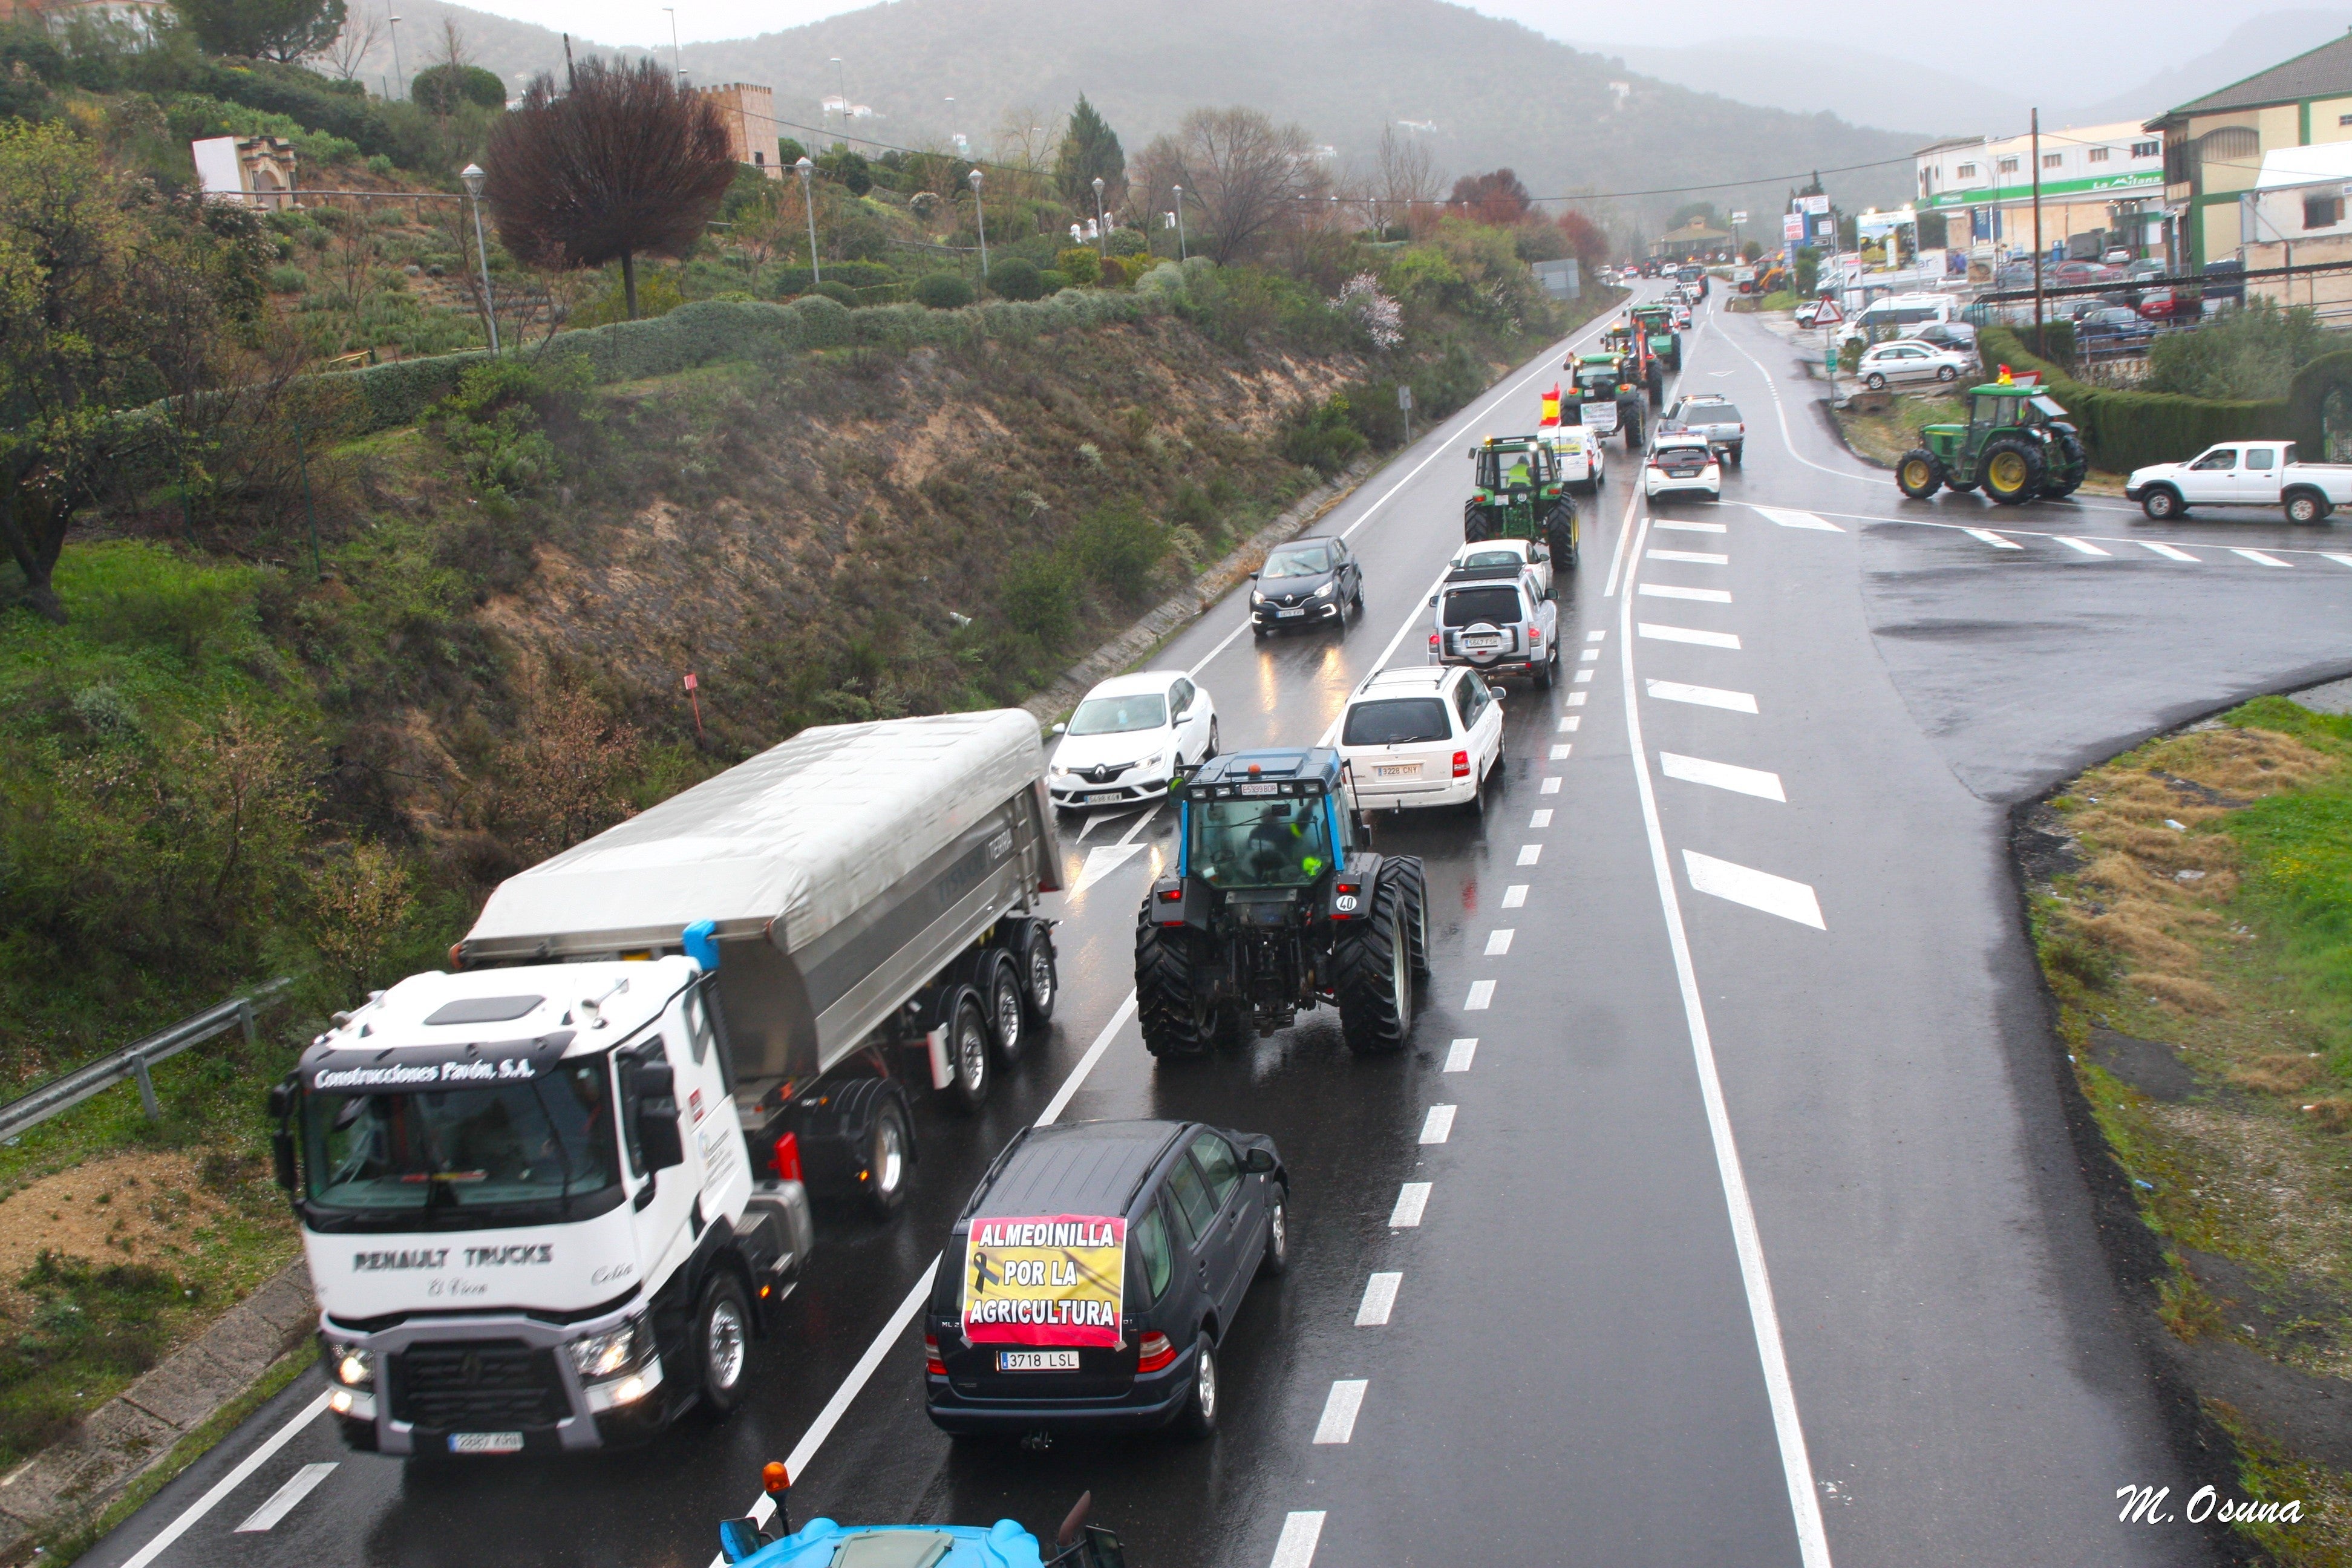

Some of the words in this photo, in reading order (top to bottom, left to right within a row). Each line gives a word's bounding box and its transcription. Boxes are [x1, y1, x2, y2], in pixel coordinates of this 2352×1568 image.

[2111, 175, 2161, 187] Milana
[1340, 897, 1354, 909] 40
[314, 1063, 439, 1089] Construcciones
[498, 1058, 535, 1079] S.A.
[978, 1223, 1115, 1247] ALMEDINILLA
[353, 1248, 450, 1273] RENAULT
[465, 1243, 554, 1268] TRUCKS
[1003, 1260, 1046, 1286] POR
[1050, 1261, 1077, 1286] LA
[969, 1299, 1115, 1326] AGRICULTURA
[1010, 1354, 1041, 1367] 3718
[1050, 1353, 1075, 1367] LSL
